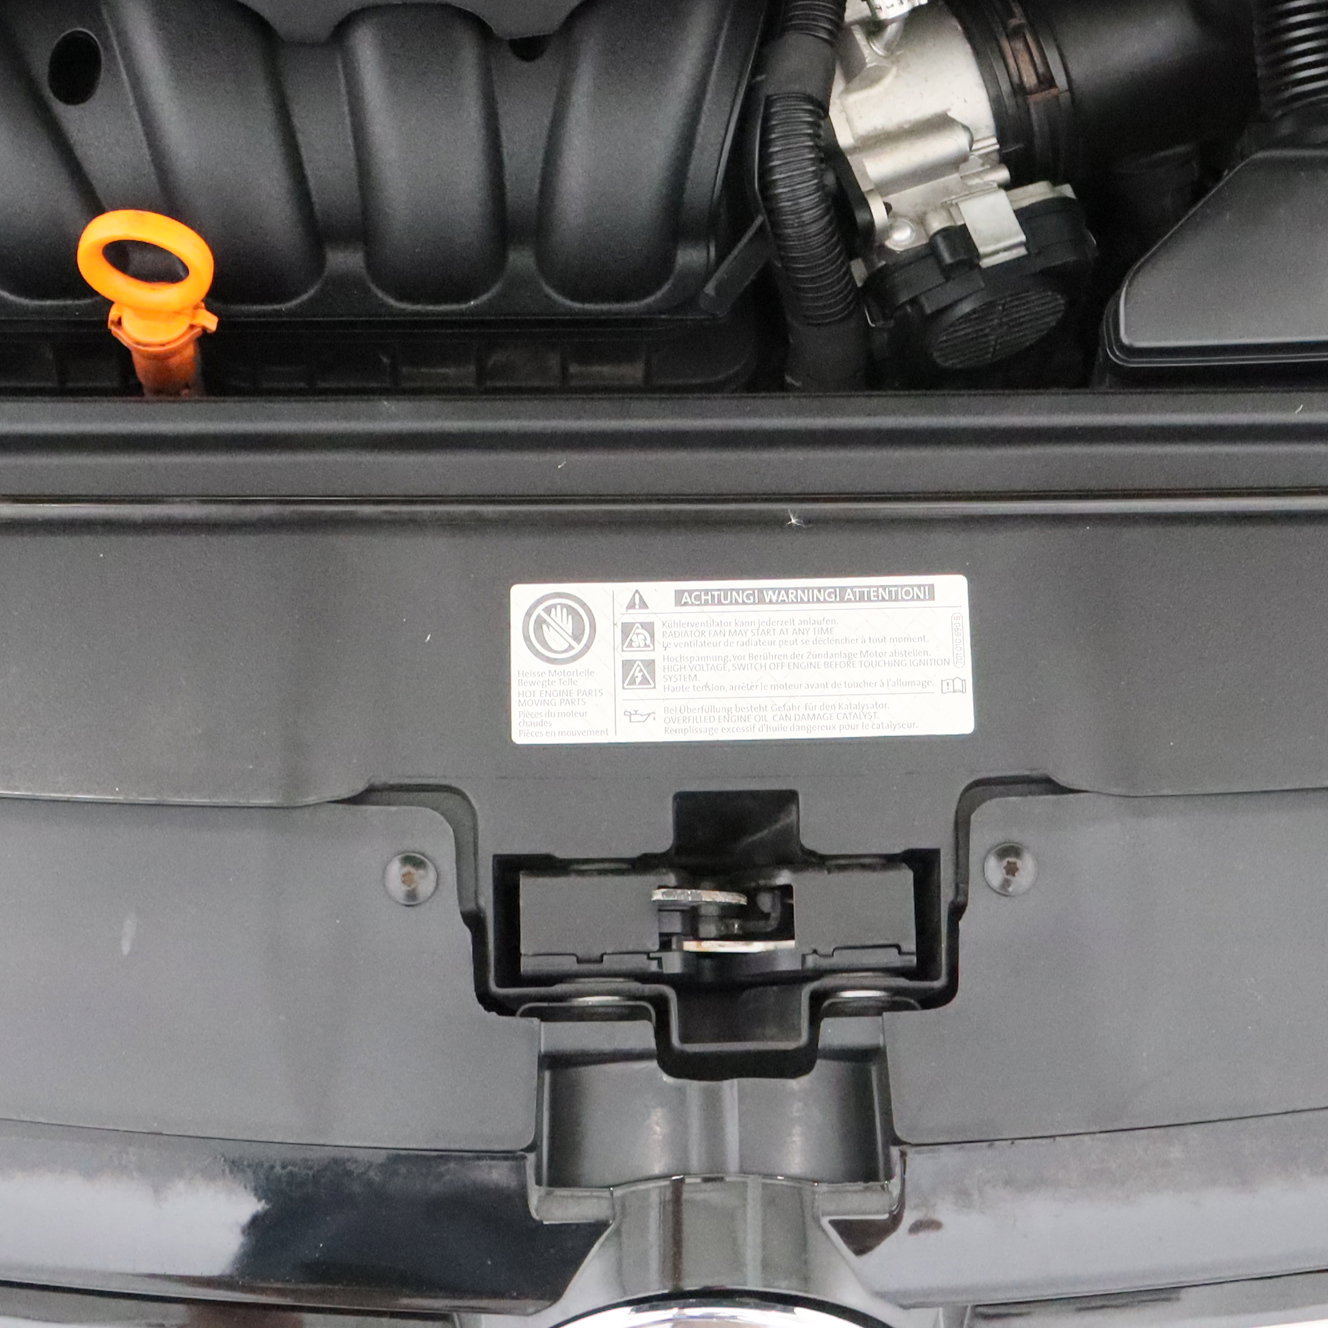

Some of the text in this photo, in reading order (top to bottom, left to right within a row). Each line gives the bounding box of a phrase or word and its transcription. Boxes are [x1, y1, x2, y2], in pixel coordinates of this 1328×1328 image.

[681, 586, 930, 606] ACHTUNG! WARNING! ATTENTION!
[734, 618, 756, 628] kann
[662, 630, 706, 638] RADIATOR
[709, 629, 726, 637] FAN
[728, 629, 748, 637] MAY
[751, 628, 776, 636] START
[778, 628, 789, 636] AT
[793, 628, 811, 636] ANY
[673, 640, 721, 648] ventilateur
[724, 639, 733, 647] de
[736, 638, 777, 647] radiateur
[778, 638, 798, 648] peut
[860, 635, 866, 644] à
[868, 635, 886, 644] tout
[748, 652, 789, 662] Berühren
[790, 651, 804, 660] der
[859, 650, 887, 658] Motor
[662, 665, 686, 673] HIGH
[732, 662, 767, 671] SWITCH
[768, 662, 785, 670] OFF
[787, 662, 822, 670] ENGINE
[824, 660, 857, 670] BEFORE
[858, 659, 908, 668] TOUCHING
[909, 658, 950, 667] IGNITION
[517, 669, 546, 678] Heisse
[663, 674, 700, 683] SYSTEM.
[517, 679, 556, 688] Bewegte
[663, 684, 690, 693] Haute
[760, 682, 768, 691] le
[770, 682, 803, 690] moteur
[804, 680, 829, 689] avant
[830, 679, 842, 688] de
[844, 679, 878, 688] toucher
[517, 688, 604, 698] HOT ENGINE PARTS
[517, 698, 586, 707] MOVING PARTS
[735, 704, 767, 713] besteht
[770, 702, 801, 712] Gefahr
[804, 702, 817, 711] für
[820, 702, 836, 711] den
[544, 709, 556, 718] du
[557, 710, 588, 718] moteur
[663, 716, 716, 725] OVERFILLED
[718, 715, 751, 723] ENGINE
[754, 714, 768, 723] OIL
[772, 714, 792, 722] CAN
[794, 712, 834, 721] DAMAGE
[518, 719, 552, 728] chaudes
[664, 726, 719, 736] Remplissage
[721, 724, 756, 733] excessif
[789, 722, 836, 733] dangereux
[839, 723, 860, 733] pour
[861, 721, 870, 730] le
[557, 728, 609, 737] mouvement
